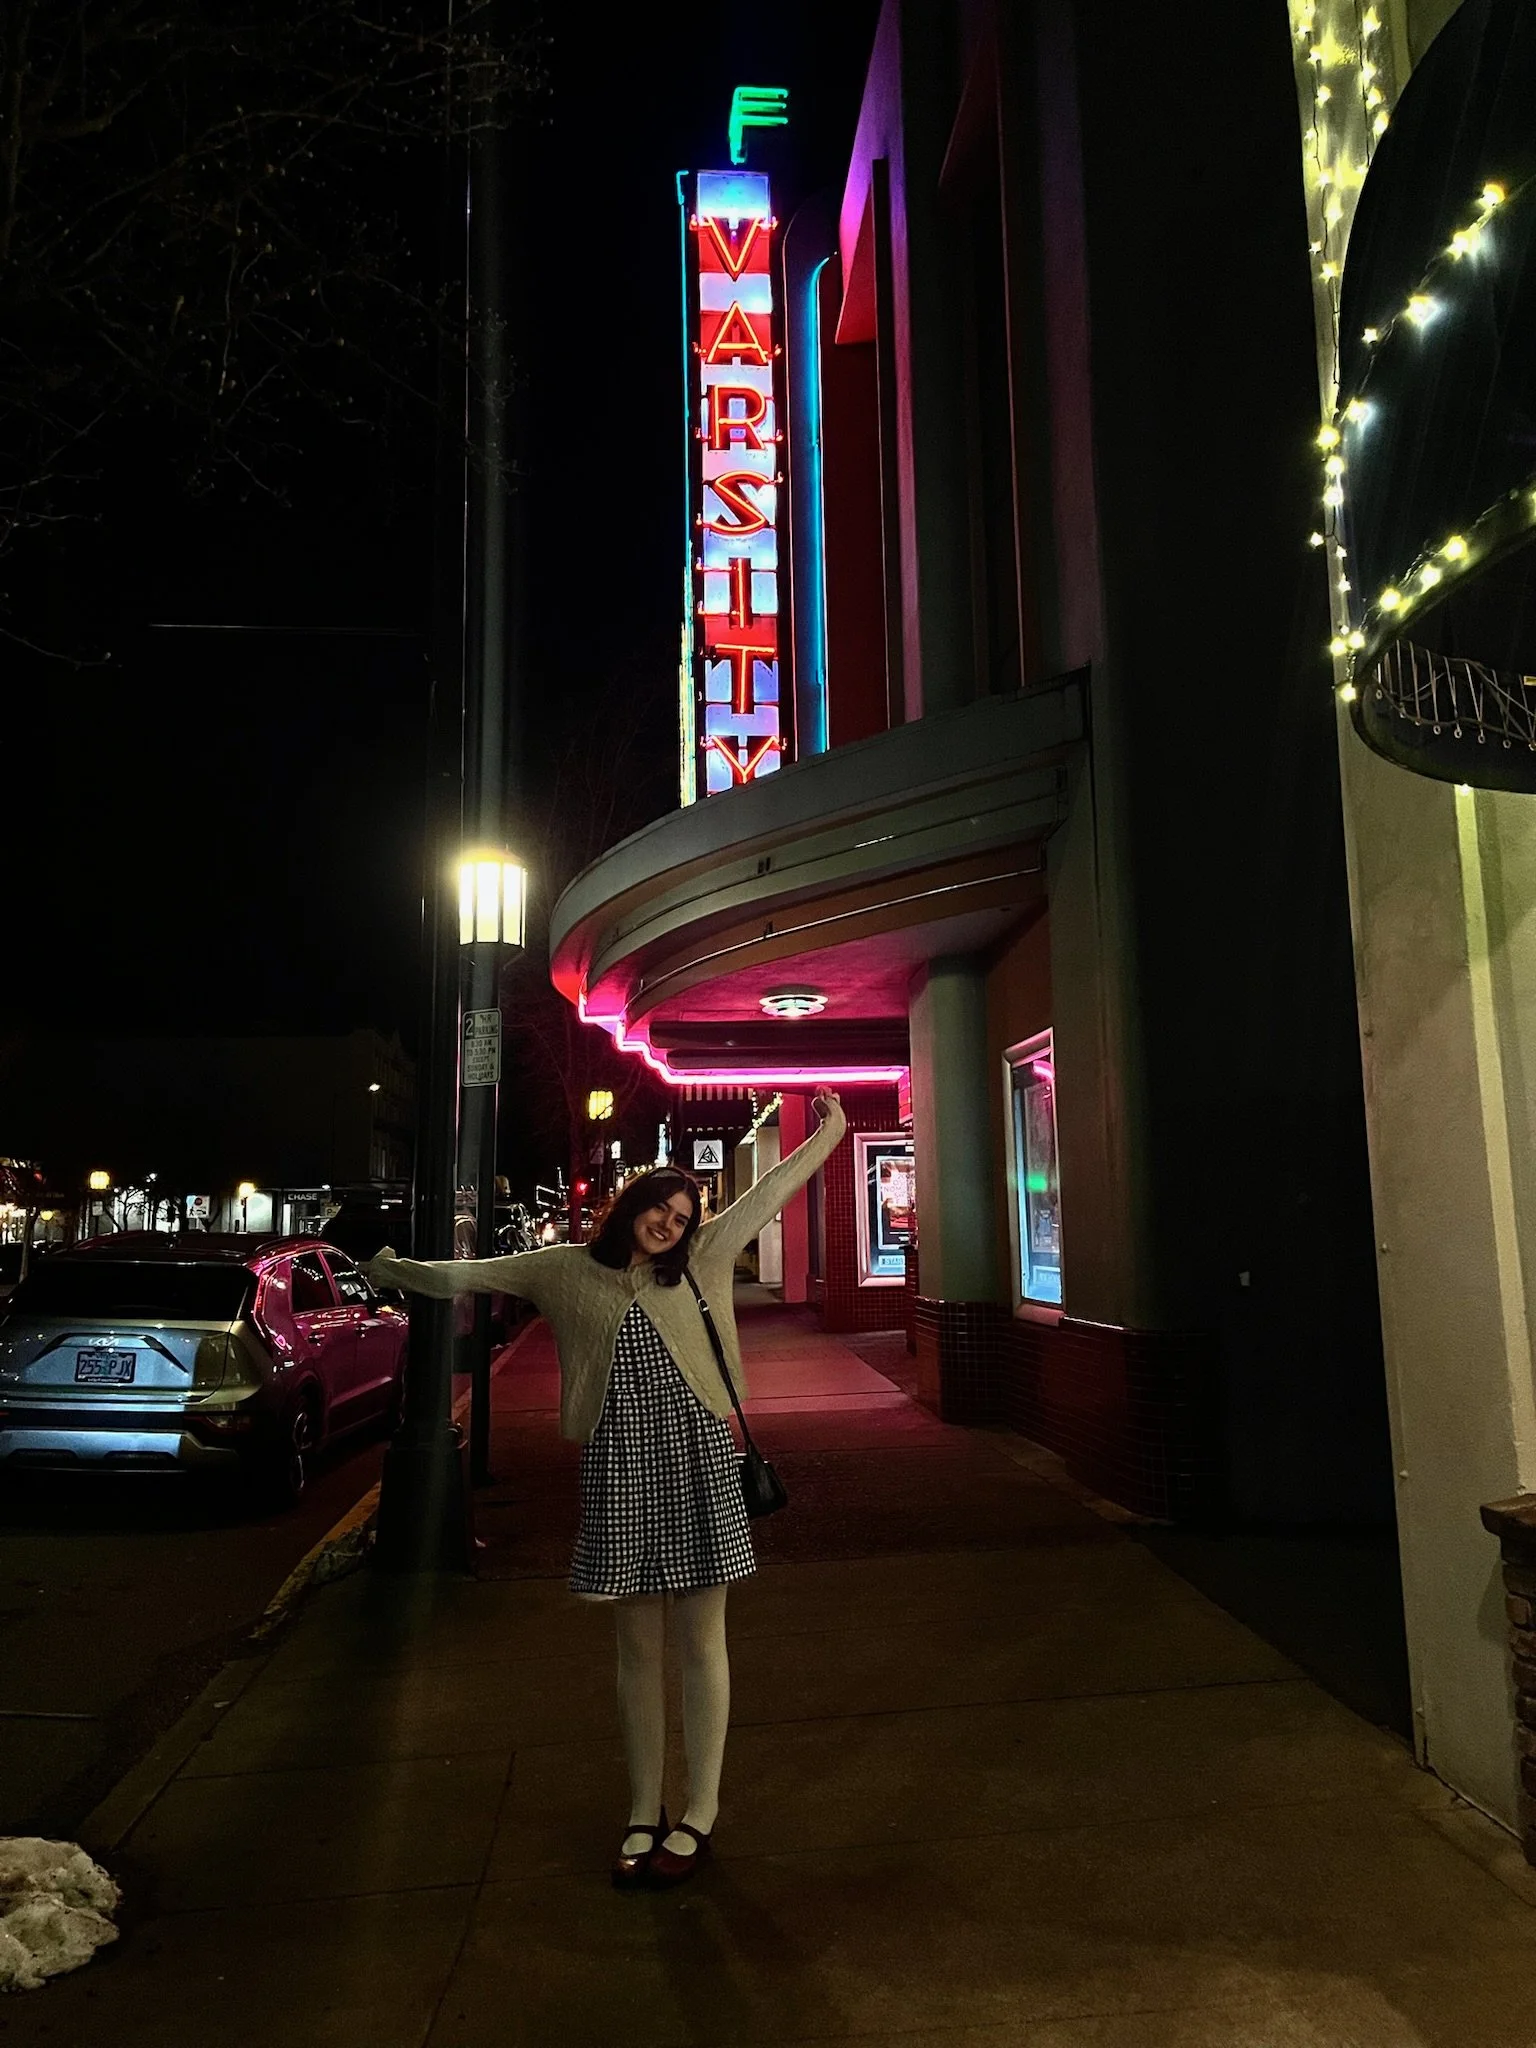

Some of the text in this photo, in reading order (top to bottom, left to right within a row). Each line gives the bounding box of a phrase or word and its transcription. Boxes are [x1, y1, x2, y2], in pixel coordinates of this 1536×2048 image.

[704, 216, 779, 783] VARSITY
[466, 1018, 473, 1036] 2
[287, 1193, 318, 1201] CHASE
[80, 1360, 131, 1376] 255 PJX
